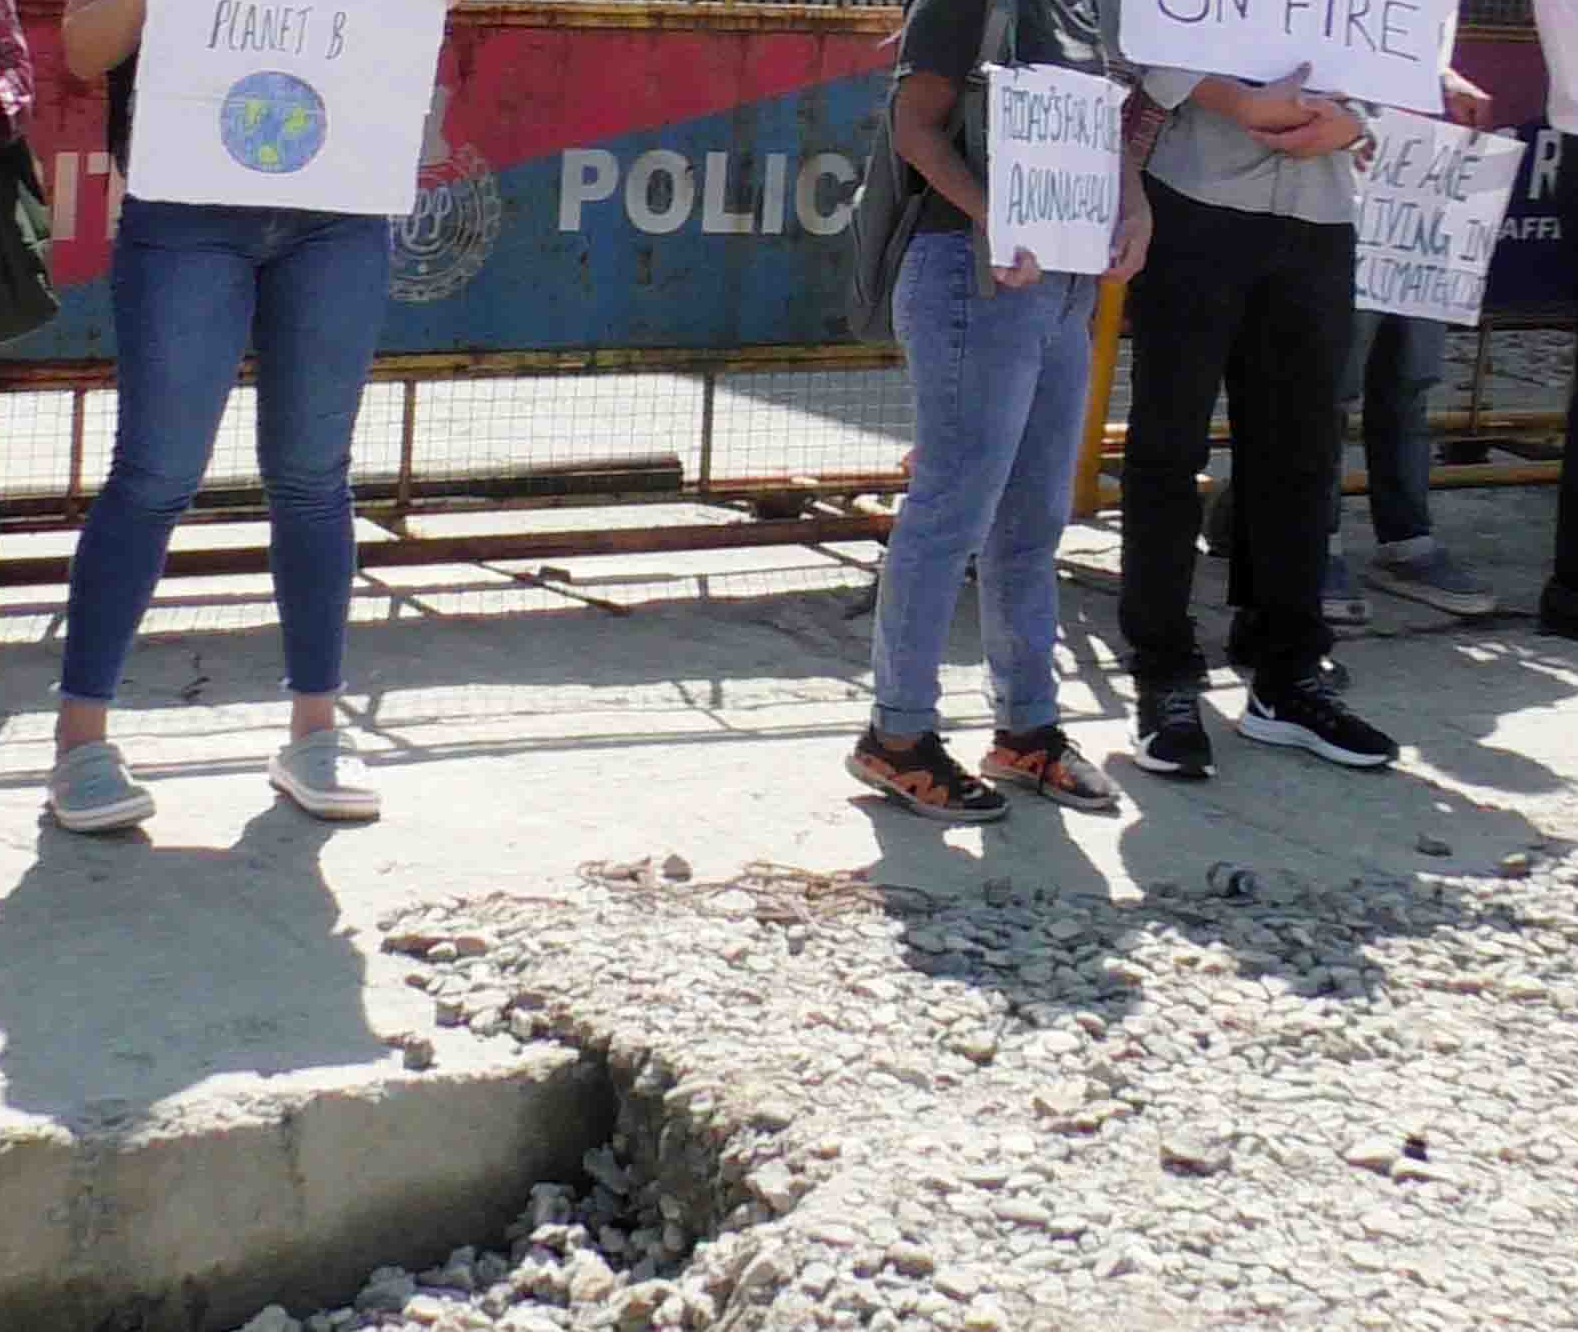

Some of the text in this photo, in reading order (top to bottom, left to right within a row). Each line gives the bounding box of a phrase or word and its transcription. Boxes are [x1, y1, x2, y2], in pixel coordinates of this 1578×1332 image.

[207, 0, 350, 60] PLANET B
[558, 148, 871, 235] POLIC
